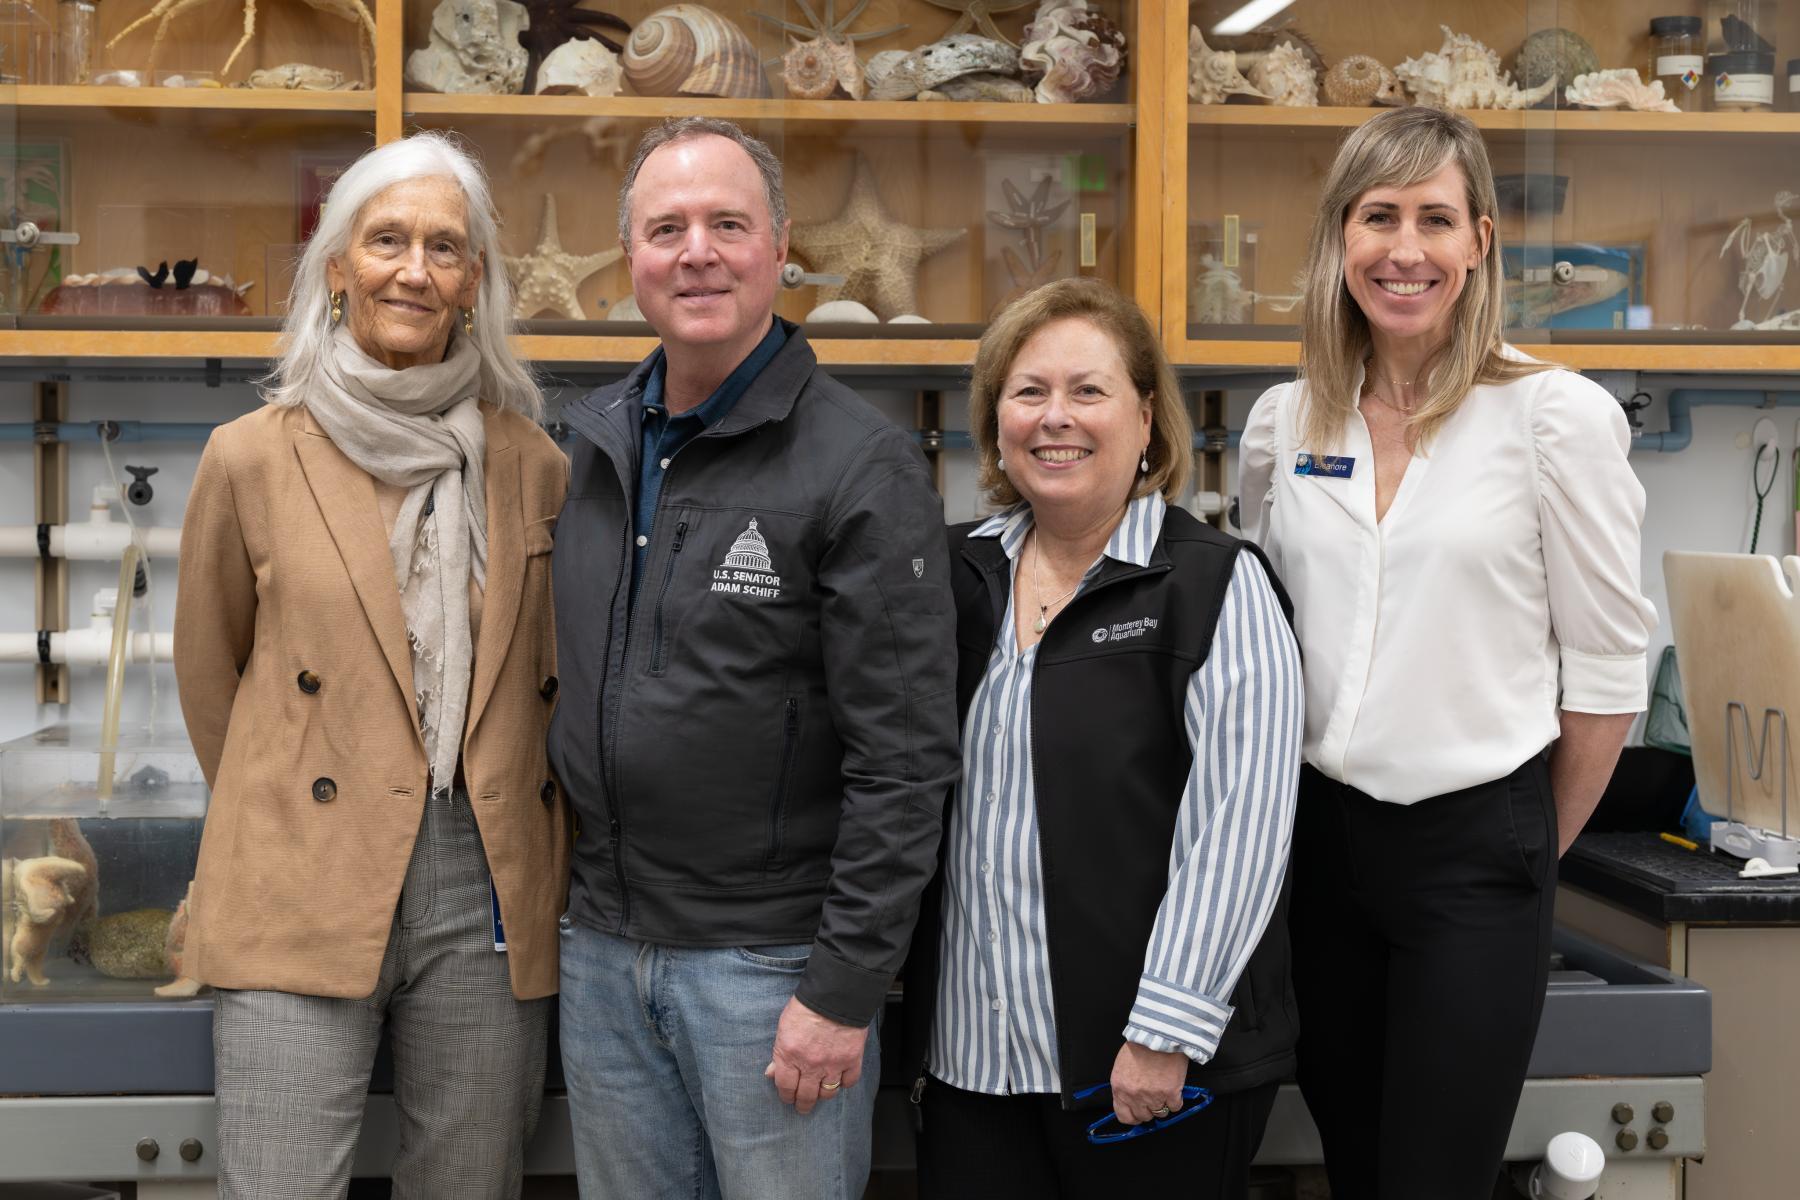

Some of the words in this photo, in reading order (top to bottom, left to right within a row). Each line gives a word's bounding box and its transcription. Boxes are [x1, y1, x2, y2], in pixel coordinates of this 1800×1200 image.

[713, 569, 731, 580] U.S.
[732, 571, 781, 586] SENATOR
[710, 581, 741, 593] ADAM
[742, 585, 781, 598] SCHIFF
[1111, 619, 1144, 633] Monterey
[1143, 616, 1159, 629] Bay
